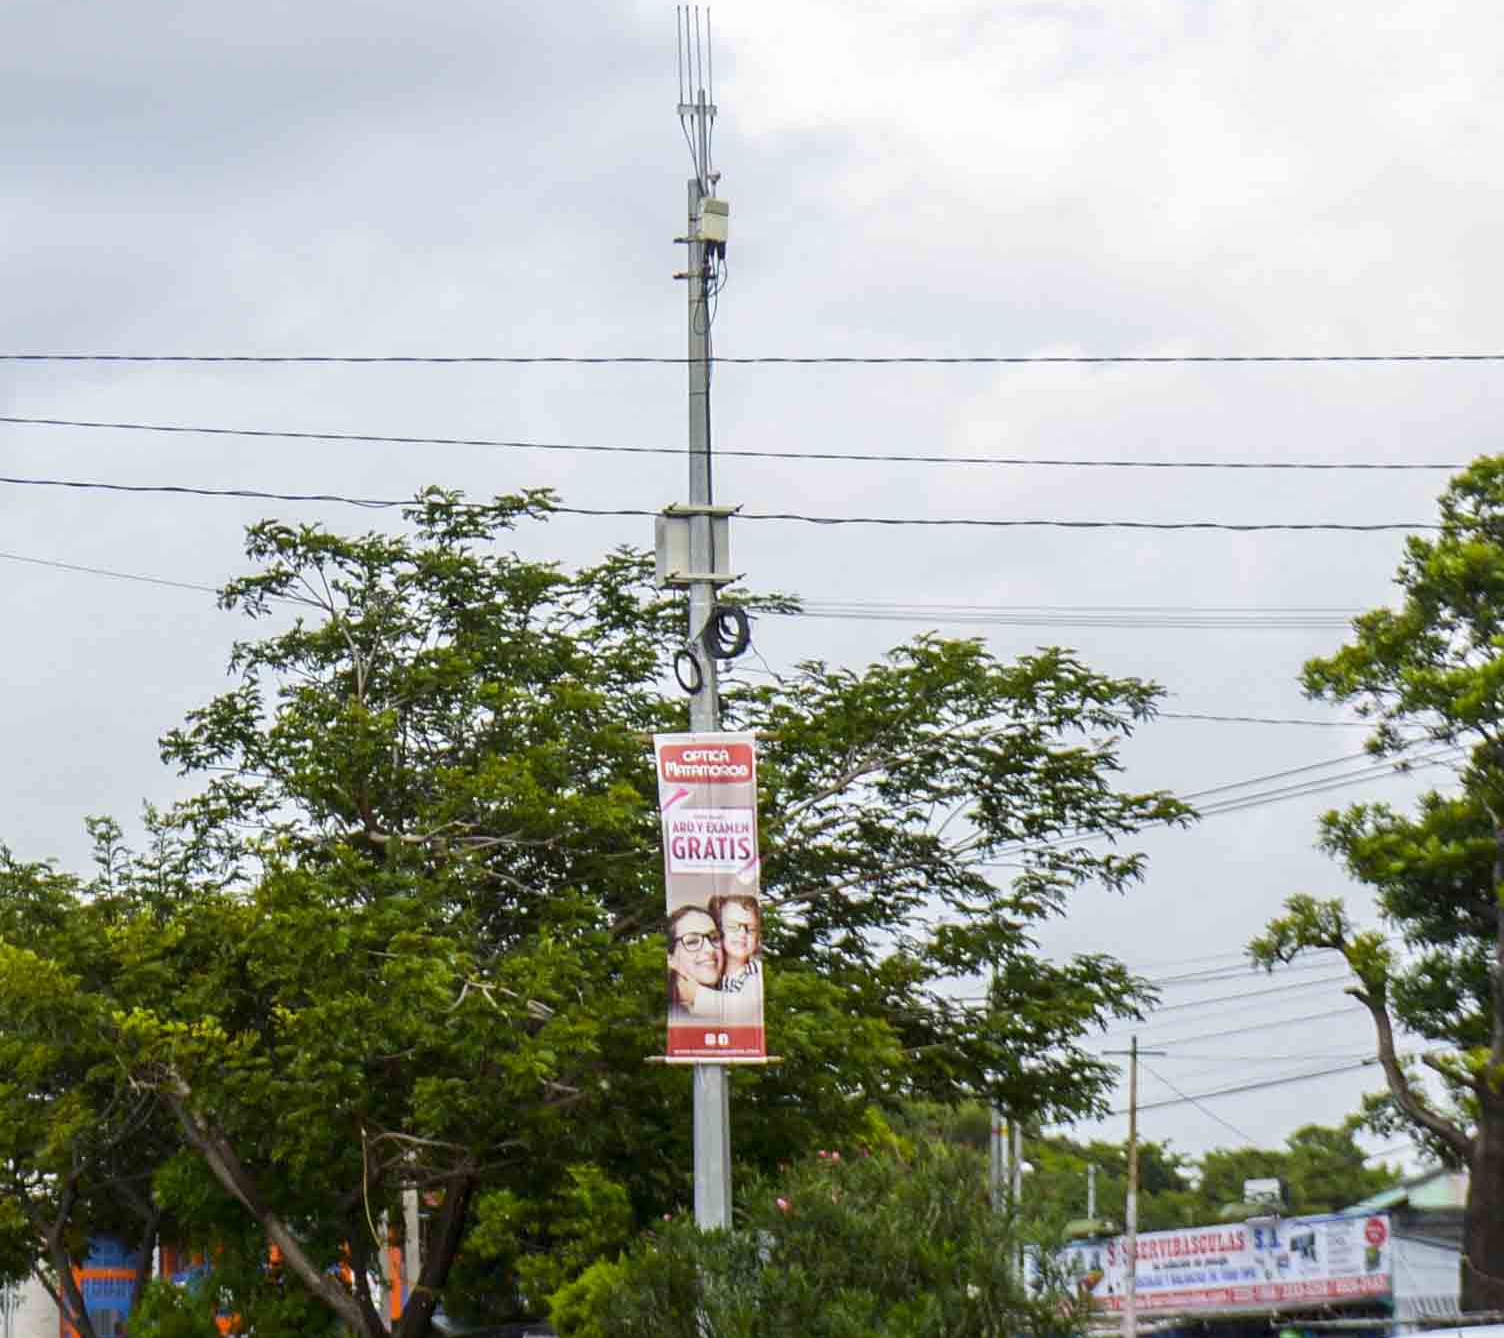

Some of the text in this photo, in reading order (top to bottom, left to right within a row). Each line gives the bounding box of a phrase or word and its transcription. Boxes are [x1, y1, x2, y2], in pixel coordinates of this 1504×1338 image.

[683, 750, 729, 762] OPTICA
[706, 821, 750, 835] EXAMEN
[672, 836, 751, 861] GRATIS
